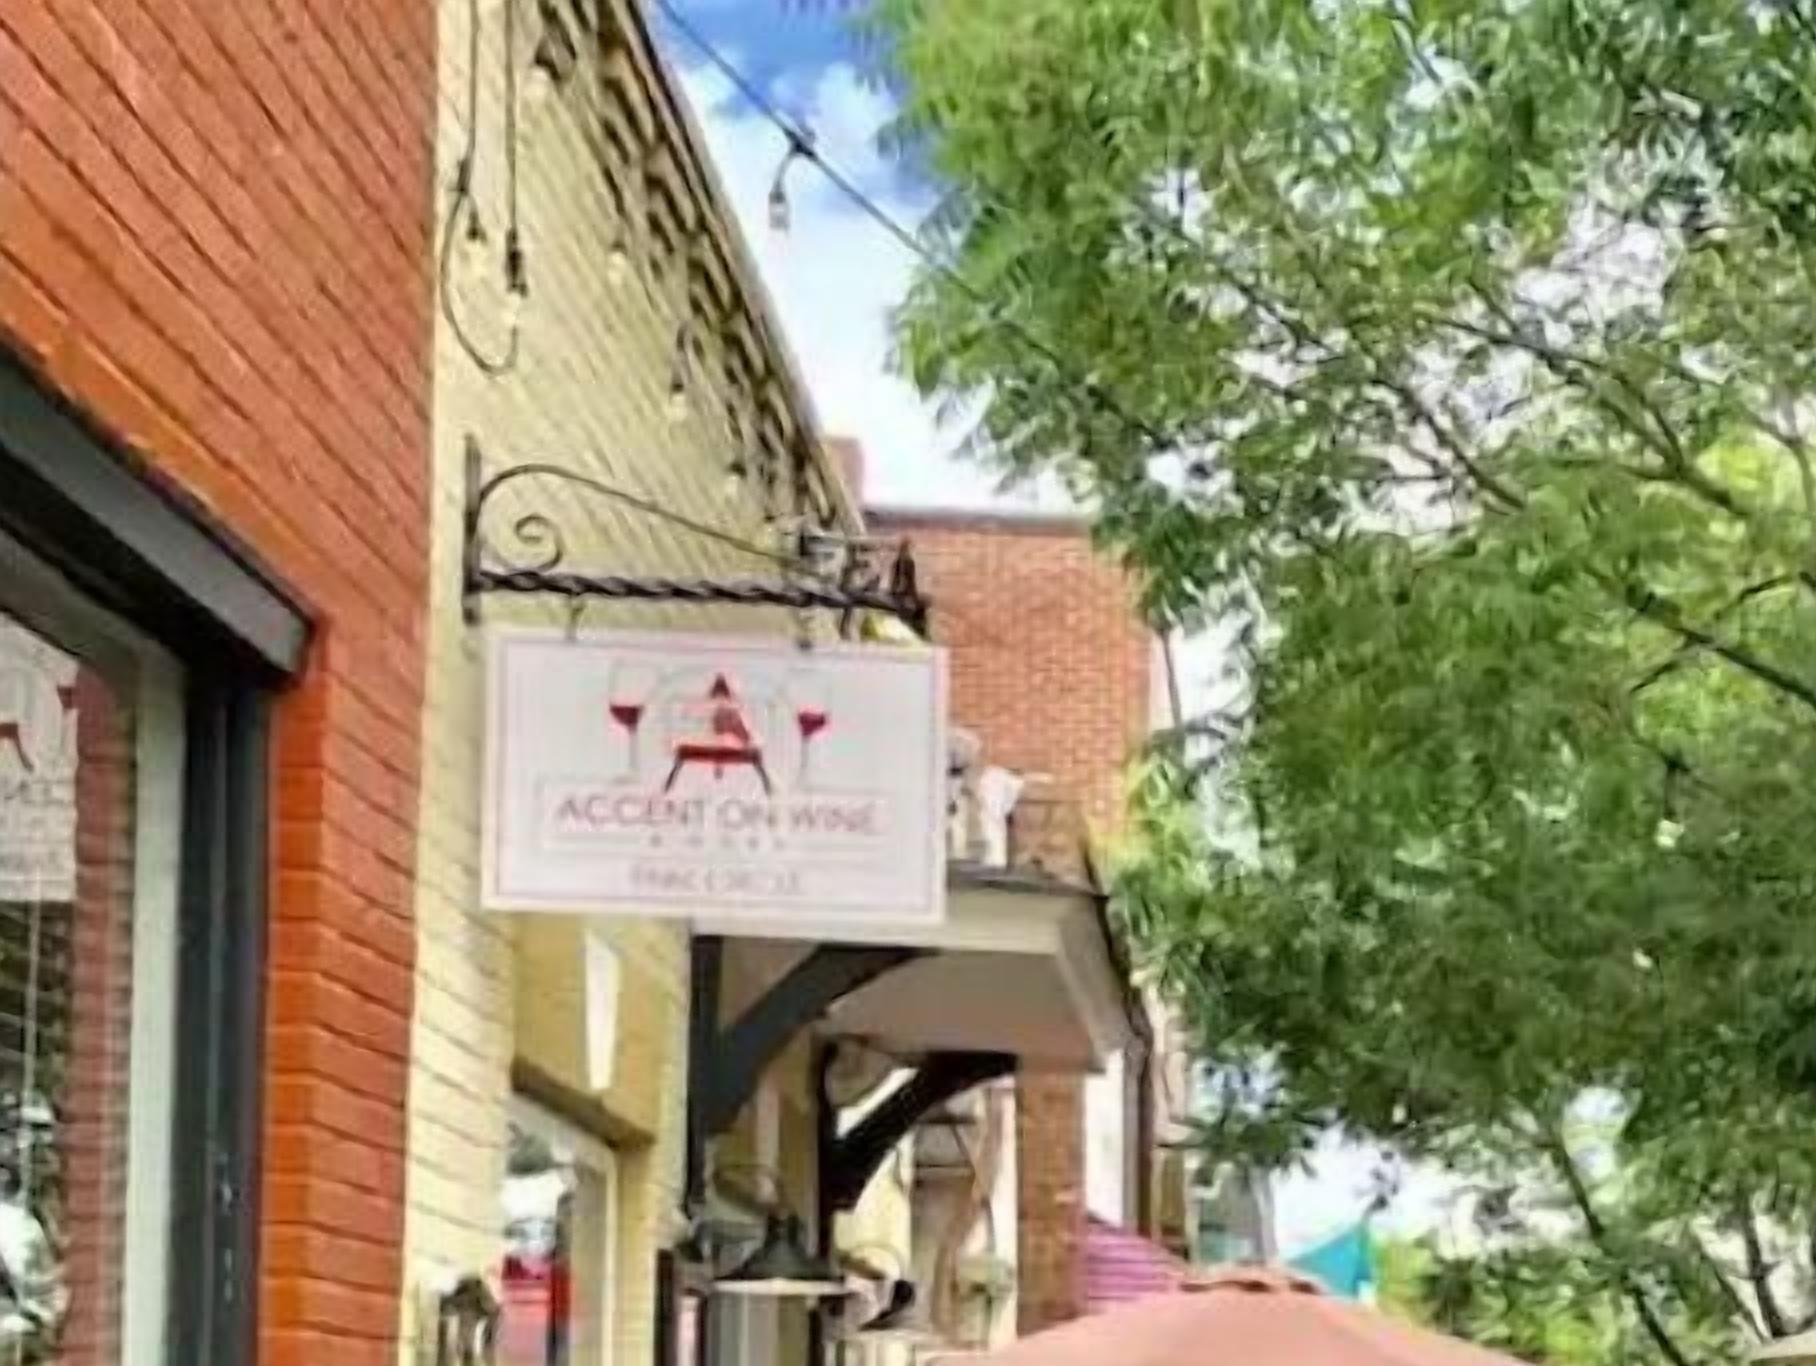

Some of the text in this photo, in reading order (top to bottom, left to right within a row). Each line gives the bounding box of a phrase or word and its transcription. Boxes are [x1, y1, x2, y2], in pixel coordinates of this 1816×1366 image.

[555, 796, 876, 834] ACCENT ON WINE
